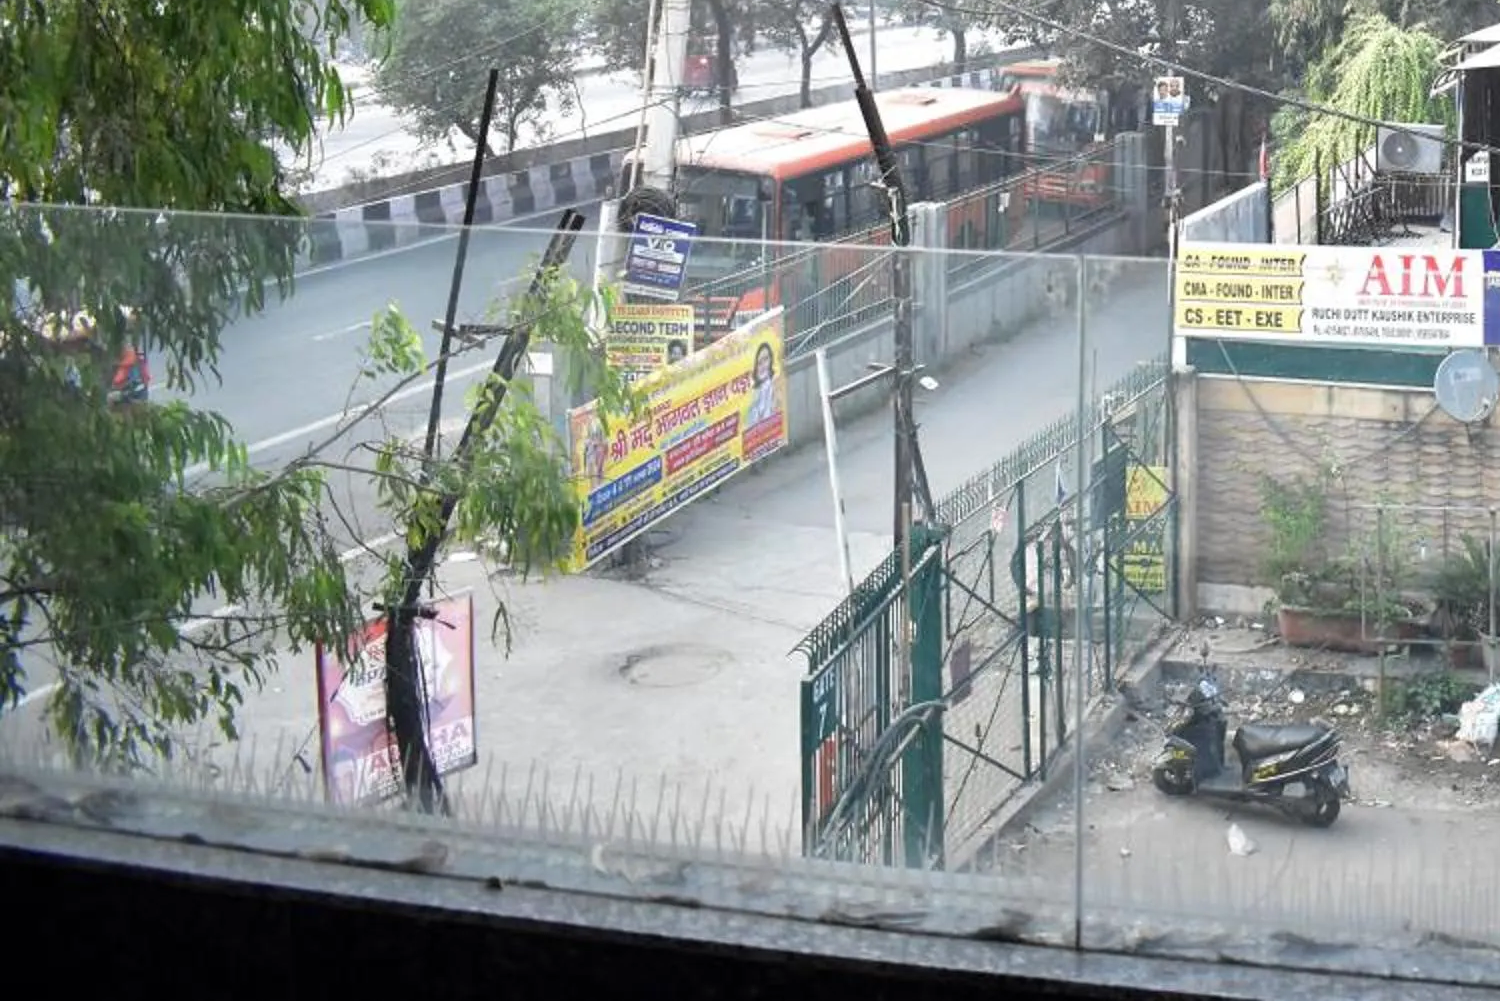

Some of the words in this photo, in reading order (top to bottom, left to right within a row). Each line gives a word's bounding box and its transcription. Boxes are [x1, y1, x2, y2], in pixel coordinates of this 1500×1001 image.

[1357, 254, 1469, 298] AIM
[1184, 281, 1206, 296] CMA
[1216, 283, 1252, 298] FOUND
[1261, 285, 1294, 300] INTER
[1184, 308, 1203, 324] CS
[1216, 309, 1243, 326] EET
[1255, 311, 1283, 328] EXE
[1417, 311, 1476, 324] ENTERPRISE
[659, 322, 689, 336] TERM
[819, 702, 828, 740] 7
